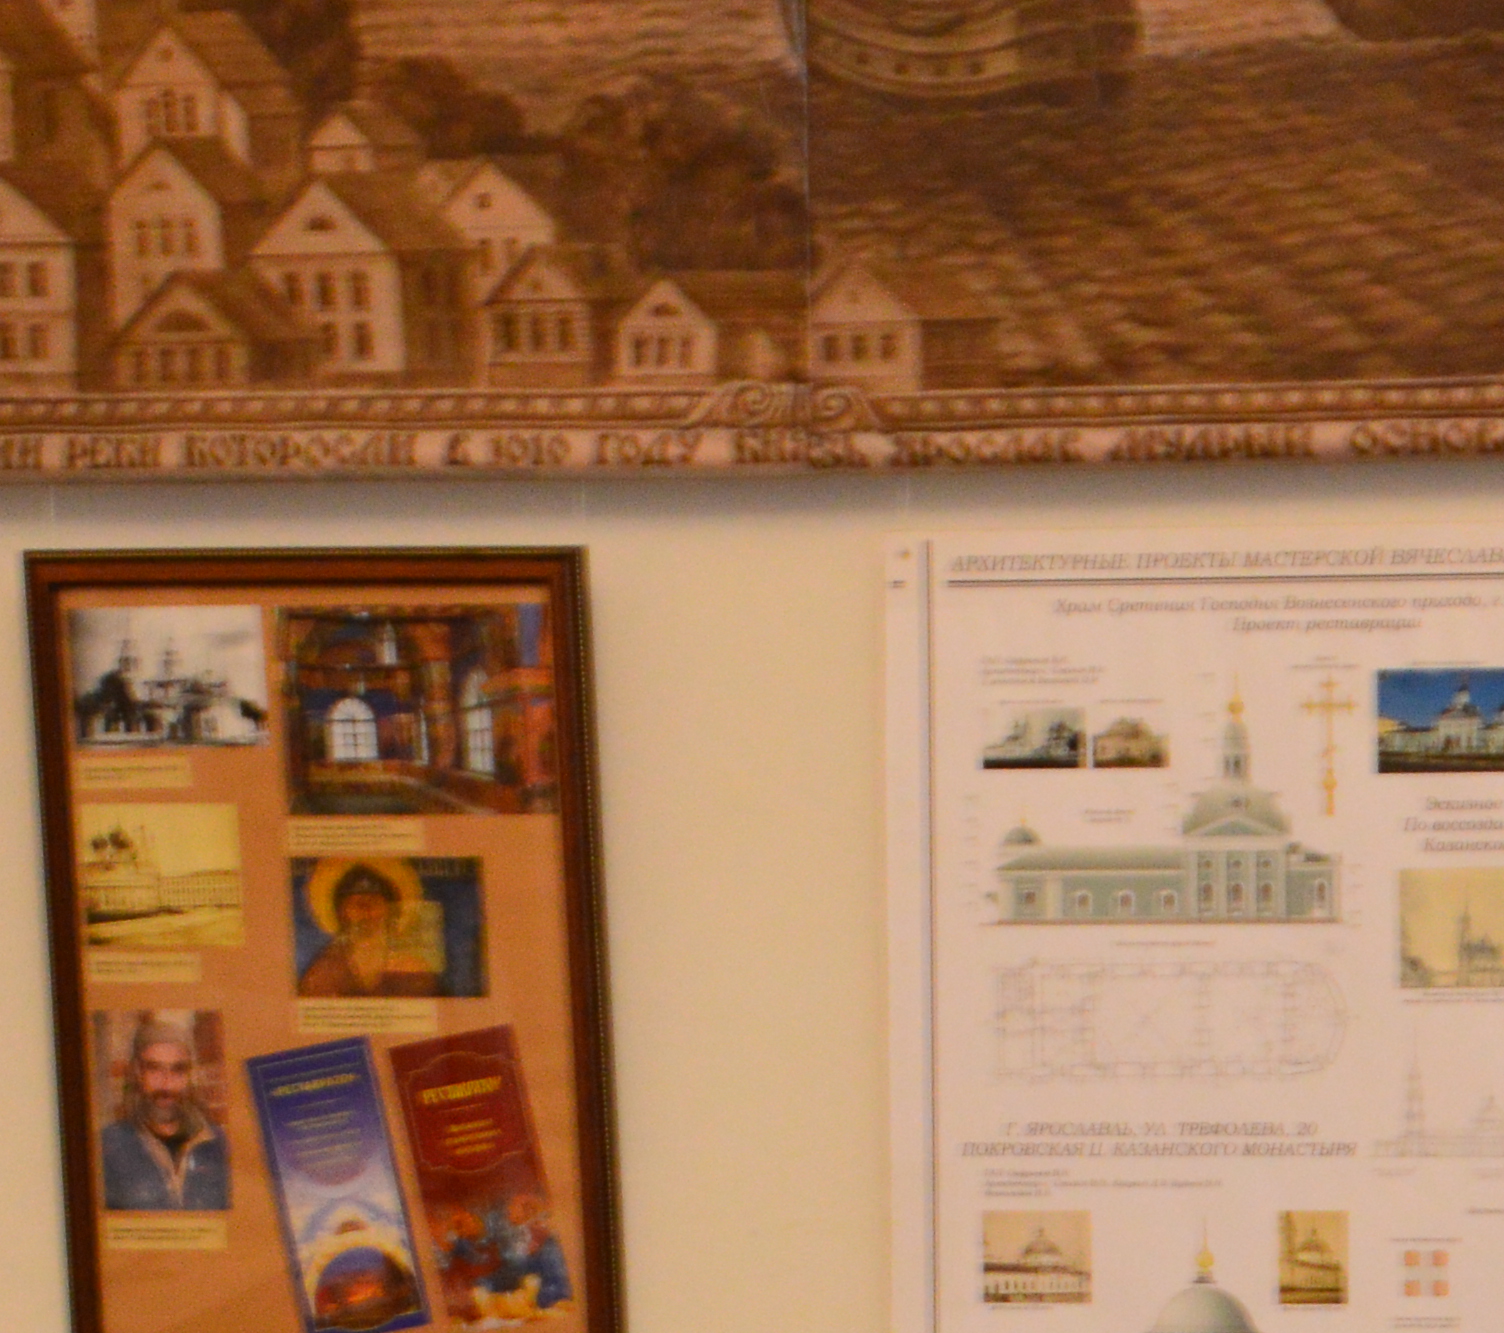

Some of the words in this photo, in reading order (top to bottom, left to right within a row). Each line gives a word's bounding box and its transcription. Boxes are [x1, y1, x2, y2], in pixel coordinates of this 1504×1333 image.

[491, 433, 572, 466] 1010
[594, 430, 704, 465] ГОДУ
[950, 553, 1129, 573] АРХИТЕКТУРНЫЕ
[1135, 551, 1238, 571] ПРОЕКТЫ
[1243, 546, 1384, 569] МАСТЕРСКОЙ
[960, 1140, 1084, 1158] ПОКРОВСКАЯ
[1111, 1140, 1238, 1157] КАЗАНСКОГО
[1241, 1140, 1359, 1157] МОНАСТЫРЯ
